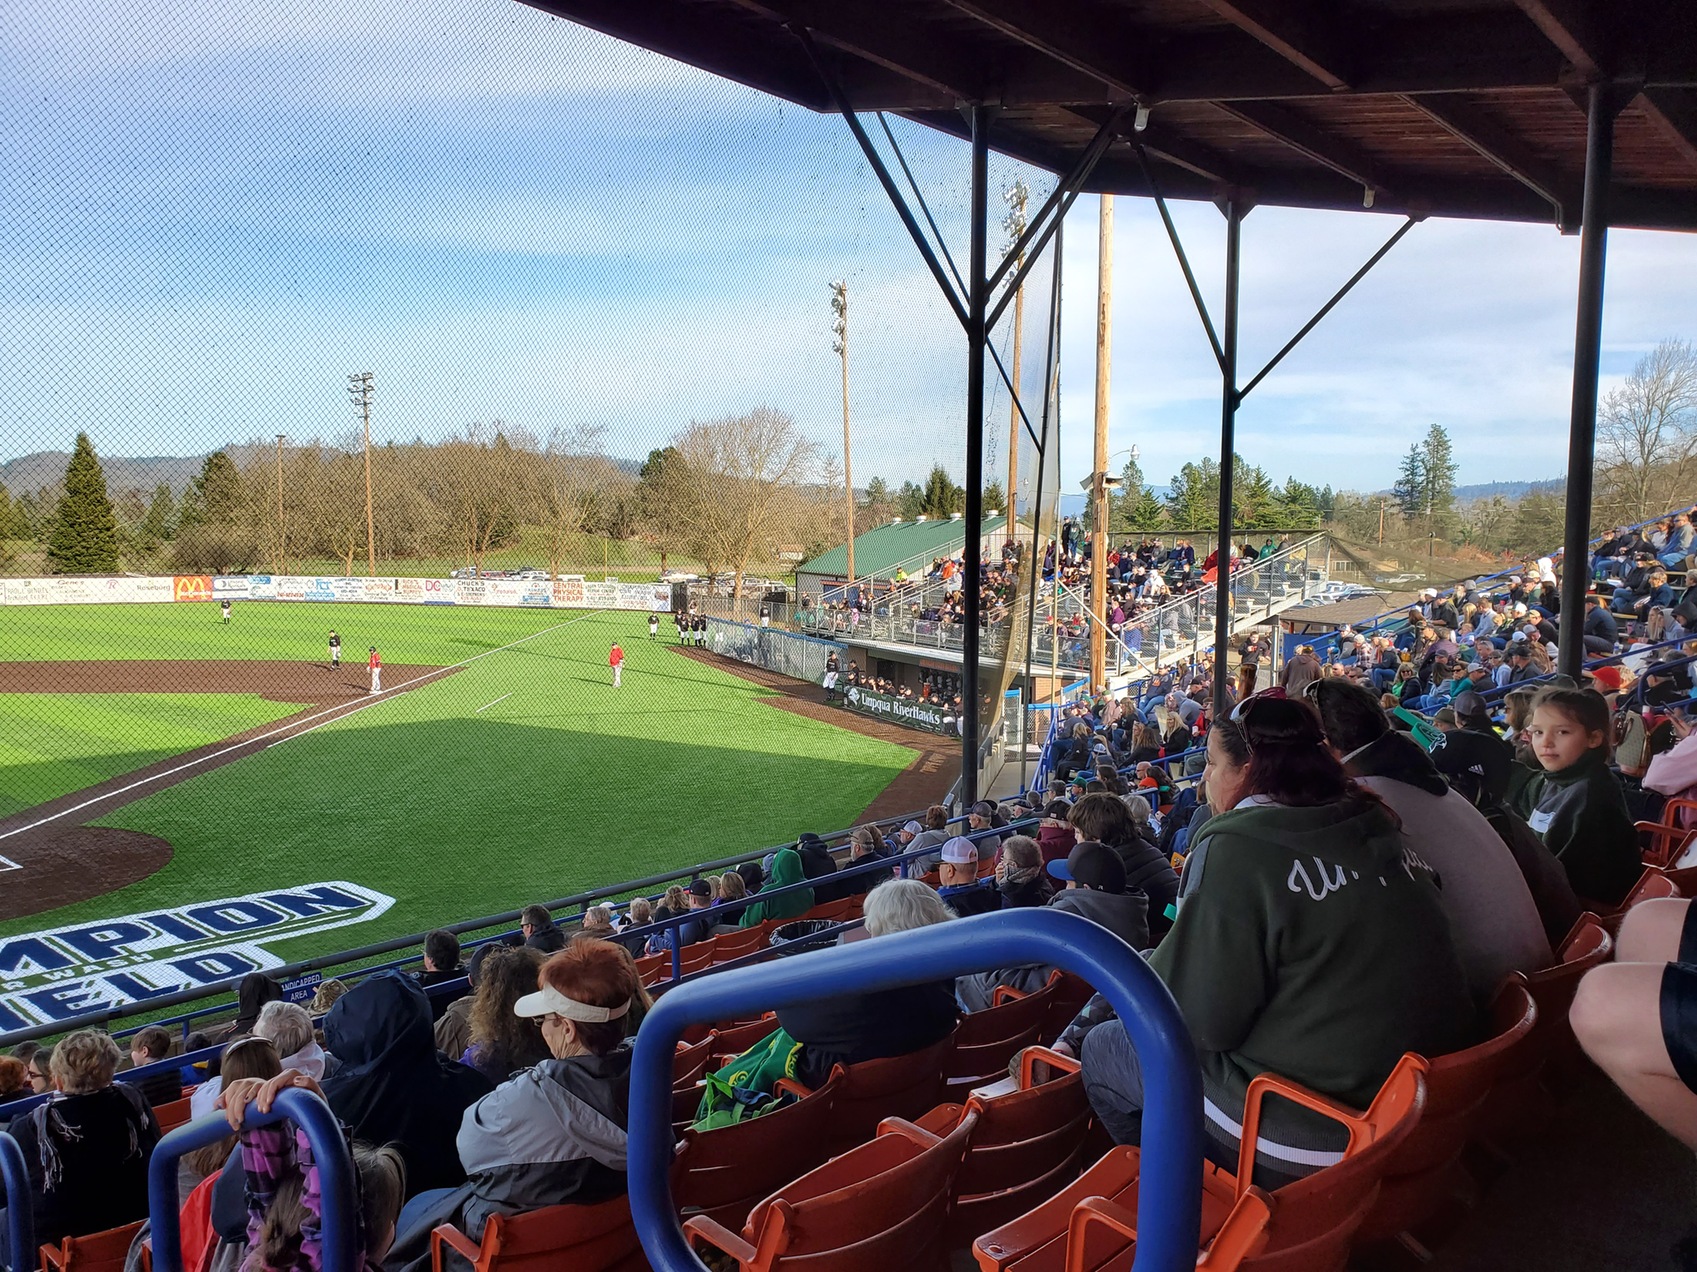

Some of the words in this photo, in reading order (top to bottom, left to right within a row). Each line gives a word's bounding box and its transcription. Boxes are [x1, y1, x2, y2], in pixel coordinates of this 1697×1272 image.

[861, 693, 891, 713] Umpqua
[893, 701, 940, 725] RiverHawks
[42, 953, 154, 981] WASH
[281, 974, 320, 990] ANDICAPPED
[290, 989, 308, 1002] AREA
